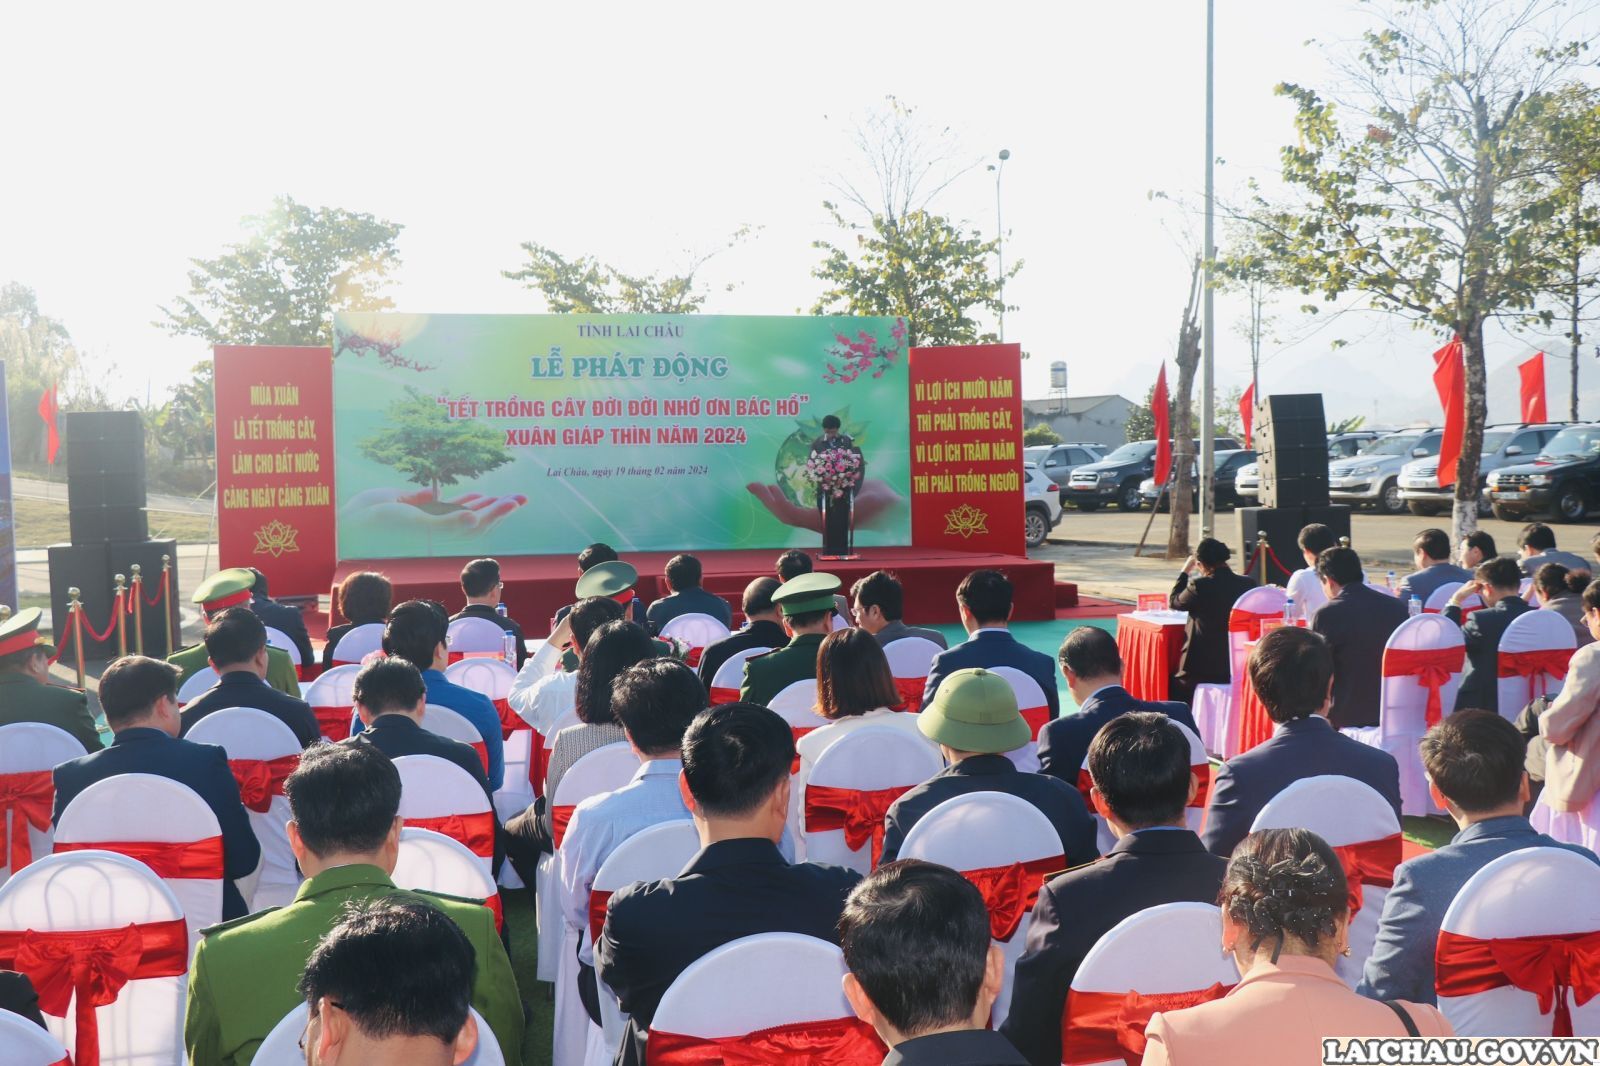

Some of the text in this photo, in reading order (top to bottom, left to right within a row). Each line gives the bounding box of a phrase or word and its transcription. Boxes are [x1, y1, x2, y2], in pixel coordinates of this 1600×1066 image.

[577, 321, 684, 337] TỈNH LAI CHÂU
[531, 347, 729, 383] LỄ PHÁT ĐỘNG
[915, 376, 1013, 405] VÌ LỢI ÍCH MƯỜI NĂM
[485, 395, 545, 417] TRỒNG
[551, 397, 586, 416] CÂY
[592, 397, 622, 416] ĐỜI
[628, 396, 658, 416] ĐỜI
[664, 396, 700, 416] NHỚ
[706, 398, 731, 416] ƠN
[736, 395, 771, 415] BÁC
[916, 410, 932, 432] THÌ
[934, 407, 956, 431] PHẢI
[506, 425, 747, 445] XUÂN GIÁP THÌN NĂM 2024
[916, 439, 1015, 466] VÌ LỢI ÍCH TRĂM NĂM
[546, 467, 561, 477] Lai
[592, 468, 613, 478] ngày
[615, 467, 626, 476] 19
[628, 466, 652, 477] tháng
[654, 466, 665, 475] 02
[667, 467, 686, 475] năm
[688, 466, 708, 475] 2024
[913, 472, 929, 494] THÌ
[931, 469, 953, 493] PHẢI
[989, 469, 1019, 492] NGƯỜI
